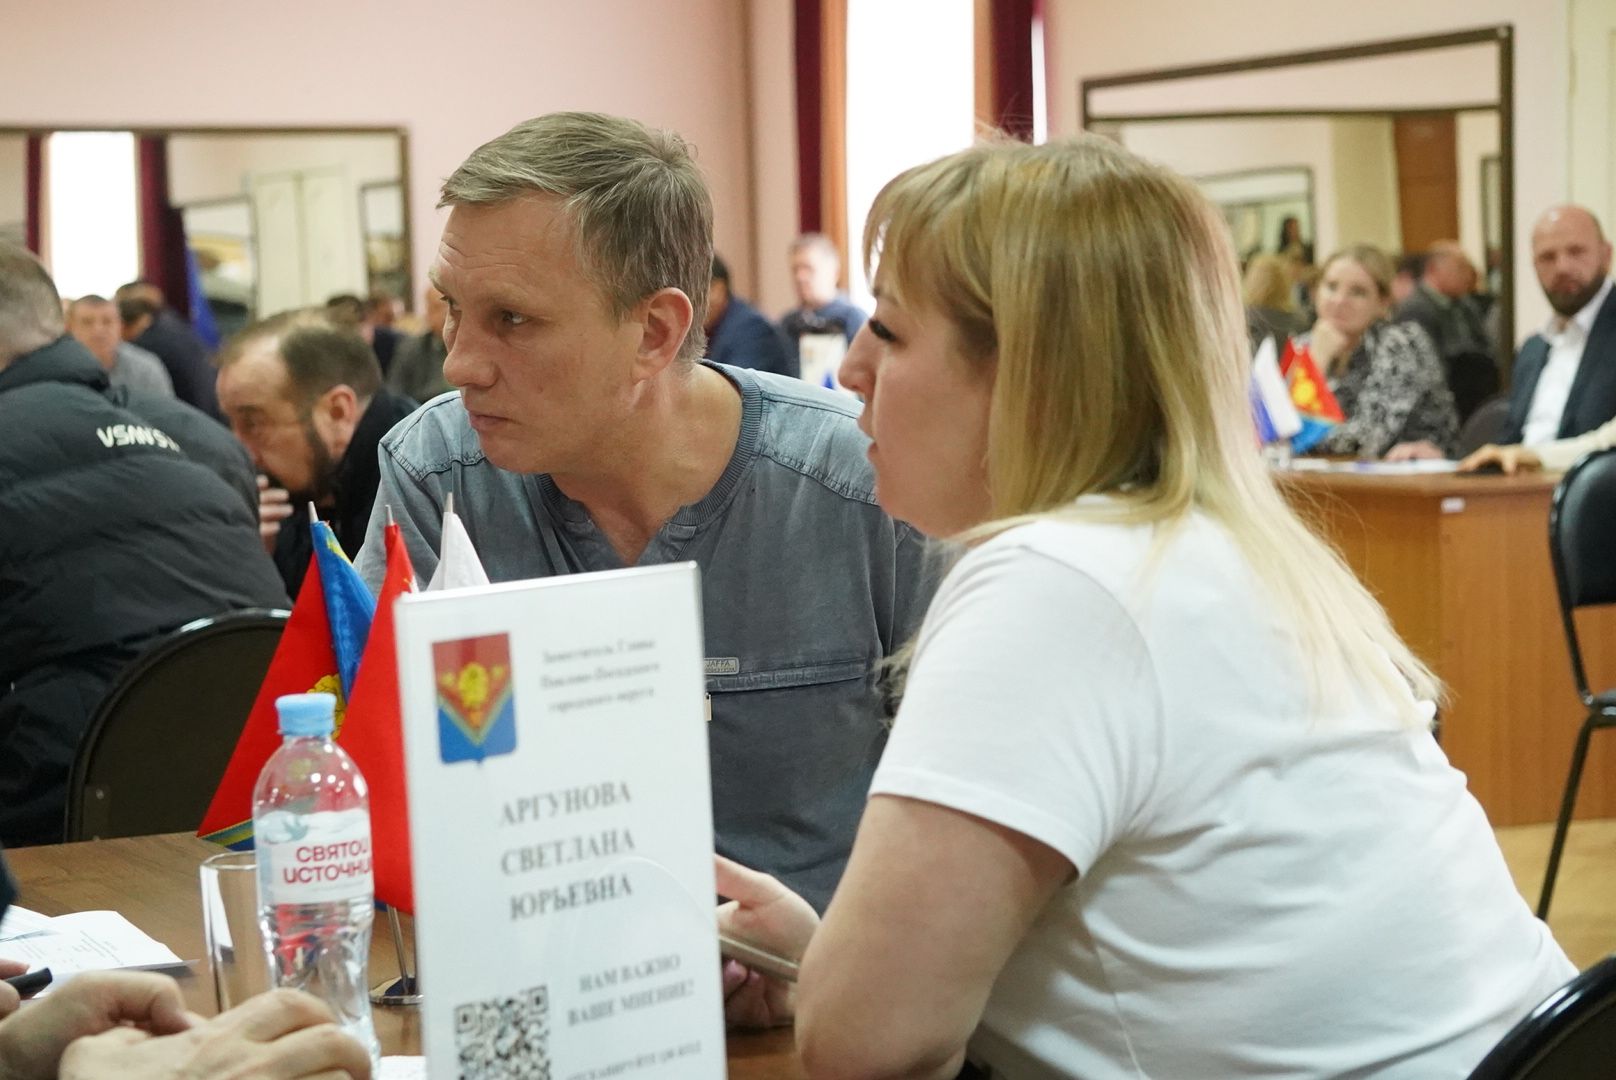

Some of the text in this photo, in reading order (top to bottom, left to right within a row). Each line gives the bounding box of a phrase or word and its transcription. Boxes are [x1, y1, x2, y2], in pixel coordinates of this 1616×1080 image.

[499, 781, 632, 828] АРГУНОВА
[500, 827, 635, 877] СВЕТЛАНА
[510, 872, 632, 922] ЮРЬЕВНА
[578, 967, 618, 995] НАМ
[567, 998, 615, 1028] ВАШЕ
